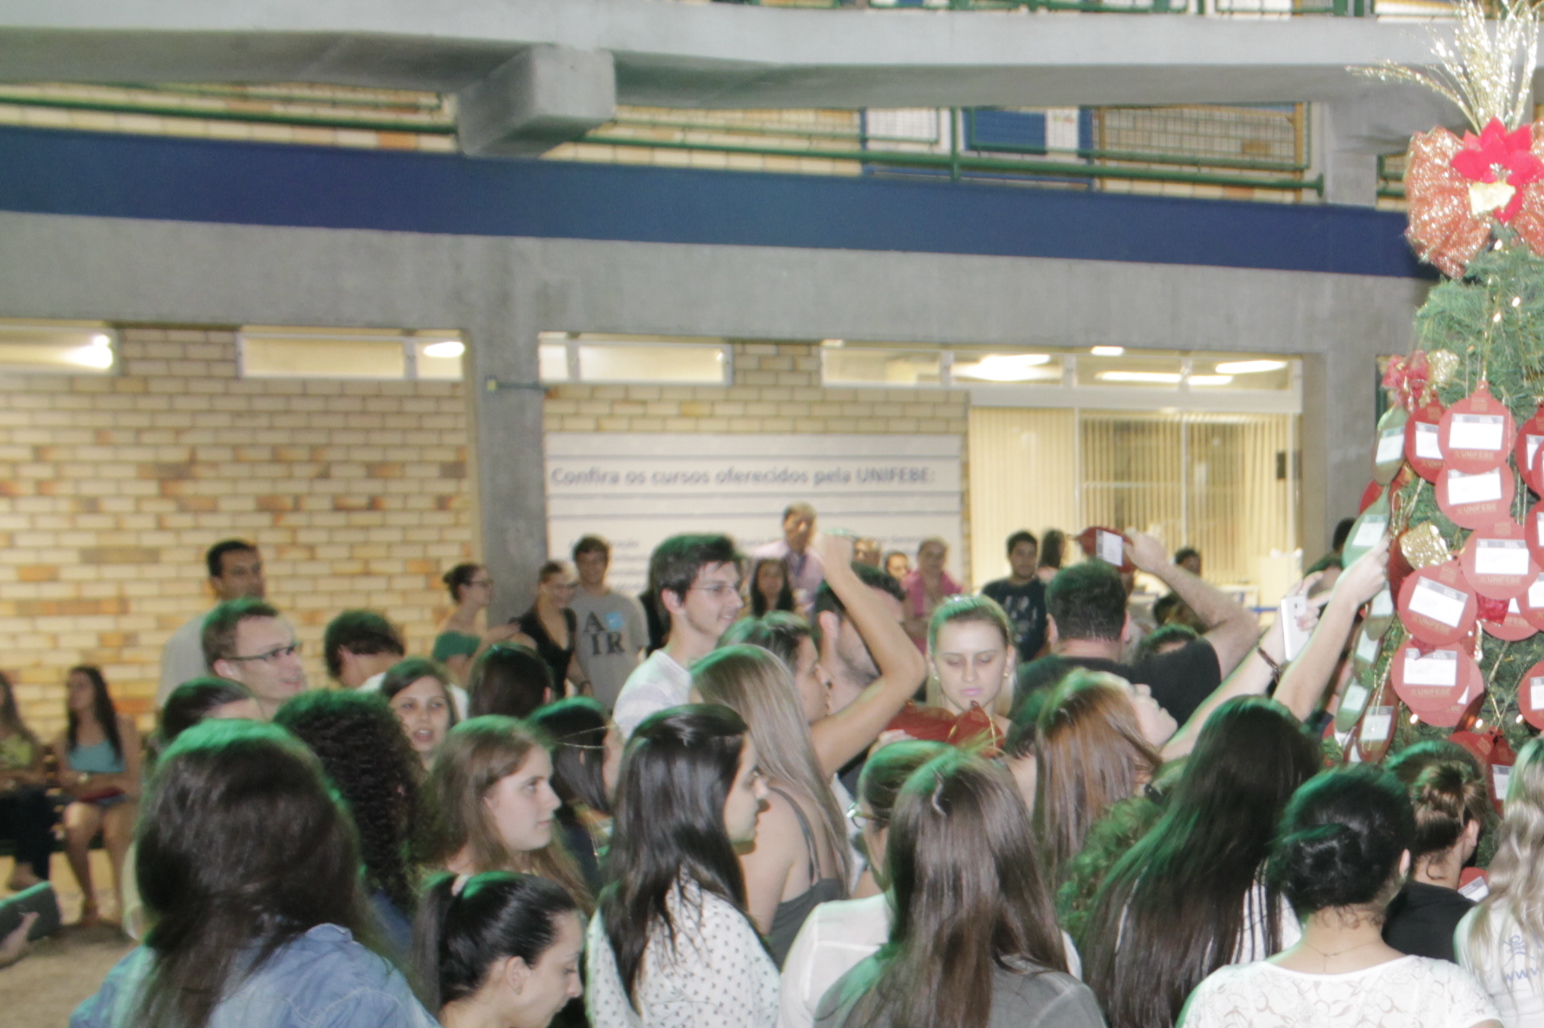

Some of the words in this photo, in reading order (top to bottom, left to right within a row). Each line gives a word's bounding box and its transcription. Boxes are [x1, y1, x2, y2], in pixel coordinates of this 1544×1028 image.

[551, 467, 620, 485] Confira
[625, 470, 646, 484] os
[652, 470, 710, 484] cursos
[715, 466, 808, 485] oferecidos
[813, 467, 850, 489] pela
